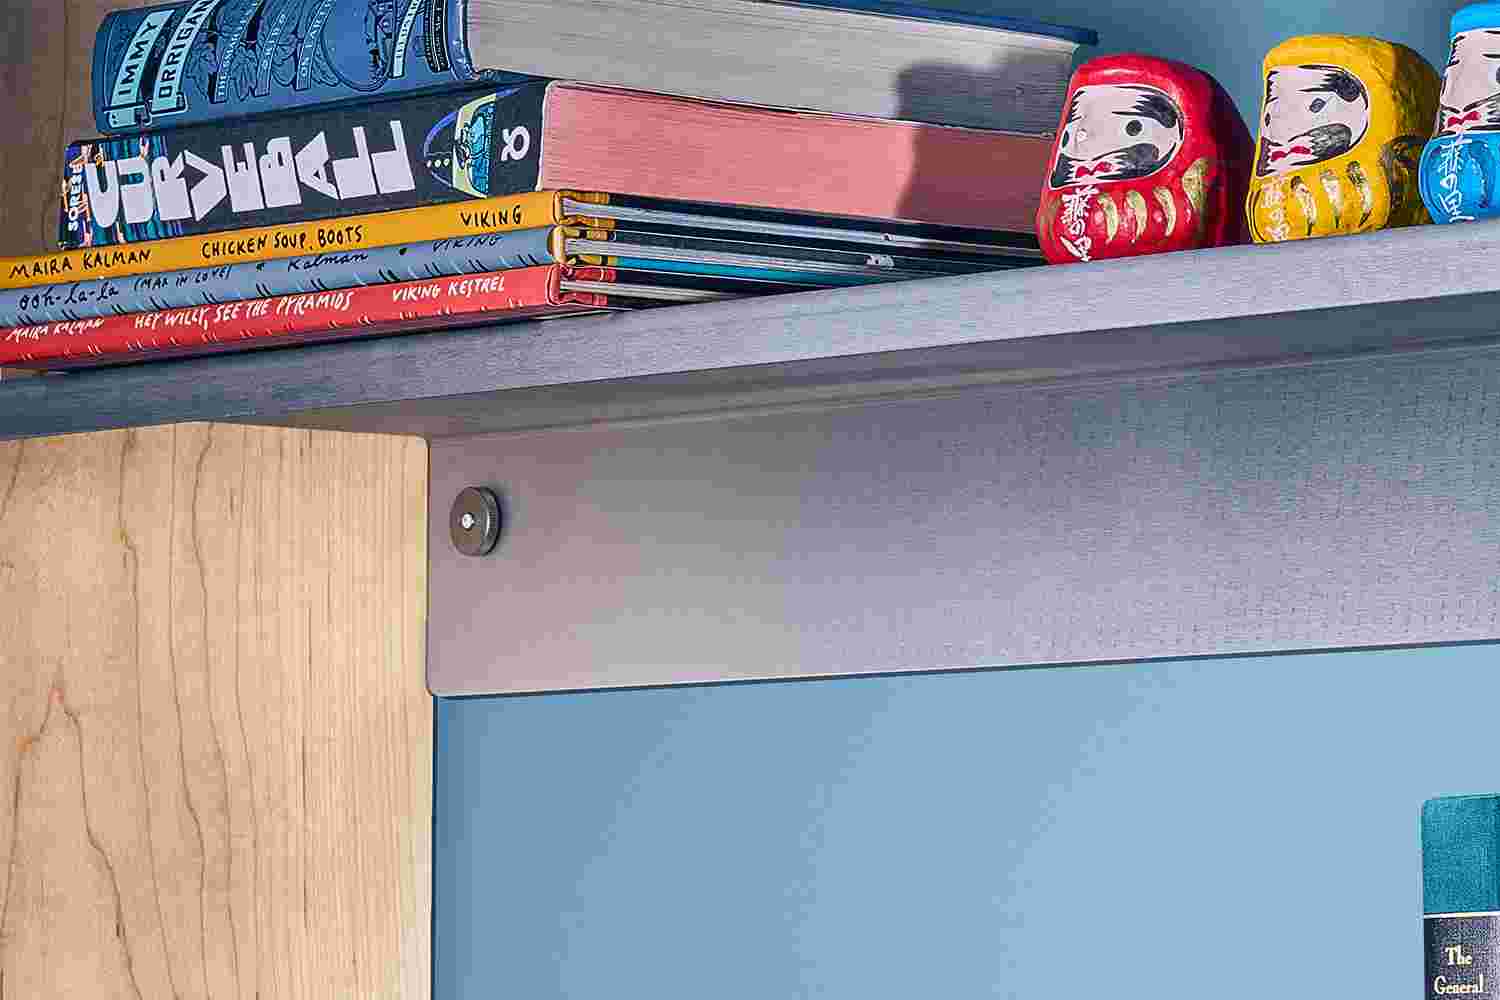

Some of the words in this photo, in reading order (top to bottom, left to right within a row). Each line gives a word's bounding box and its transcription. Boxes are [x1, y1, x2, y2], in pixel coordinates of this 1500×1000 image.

[9, 256, 73, 279] MAIRA
[83, 249, 153, 270] KALMAN
[201, 235, 267, 260] CHICKEN
[317, 224, 364, 248] BOOTS
[460, 204, 523, 228] VIKING
[288, 252, 368, 273] Kalman
[134, 313, 160, 330] HEY
[214, 302, 242, 322] SEE
[245, 298, 271, 317] THE
[277, 291, 355, 315] PYRAMIDS
[392, 284, 441, 303] VIKING
[447, 276, 506, 297] KESTREL
[1443, 946, 1473, 967] The
[1433, 975, 1485, 995] General
